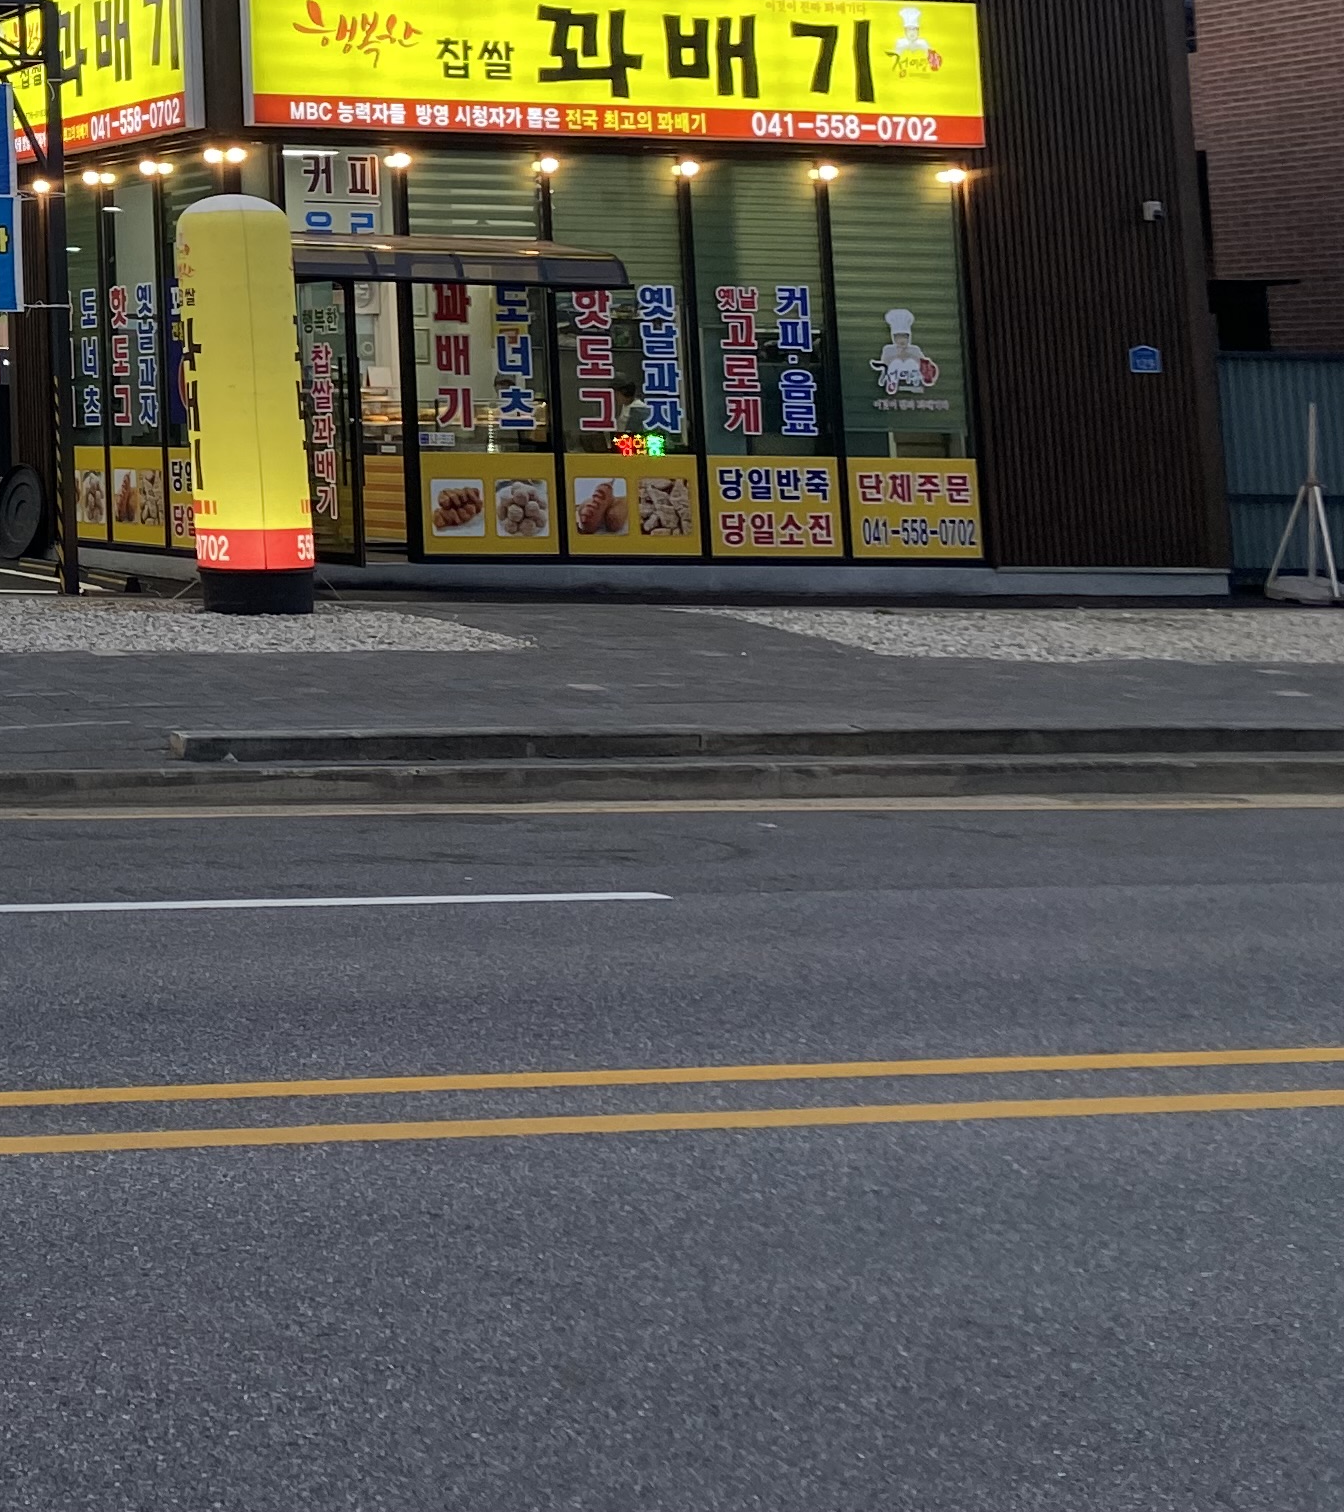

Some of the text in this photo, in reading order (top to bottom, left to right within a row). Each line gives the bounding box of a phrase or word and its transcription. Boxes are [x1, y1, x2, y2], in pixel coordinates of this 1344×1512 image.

[436, 4, 876, 102] 찹쌀 꽈배기
[91, 97, 181, 142] 041-558-0702
[290, 102, 938, 142] MBC 능력자들 방영 시청자가 뽑은 전국 최고의 꽈배기 041-558-0702
[302, 155, 379, 196] 커피
[302, 307, 340, 334] 행복한
[715, 286, 759, 311] 옛날
[80, 289, 101, 426] 도너츠
[109, 285, 132, 426] 핫도그
[135, 282, 158, 427] 옛날과자
[572, 289, 617, 432] 핫도그
[637, 284, 683, 433] 옛날과자
[720, 312, 763, 436] 고로케
[311, 343, 338, 520] 찹쌀꽈배기
[717, 468, 831, 502] 당일반죽
[857, 472, 973, 505] 단체주문
[721, 512, 834, 547] 당일소진
[863, 518, 977, 547] 041-558-0702
